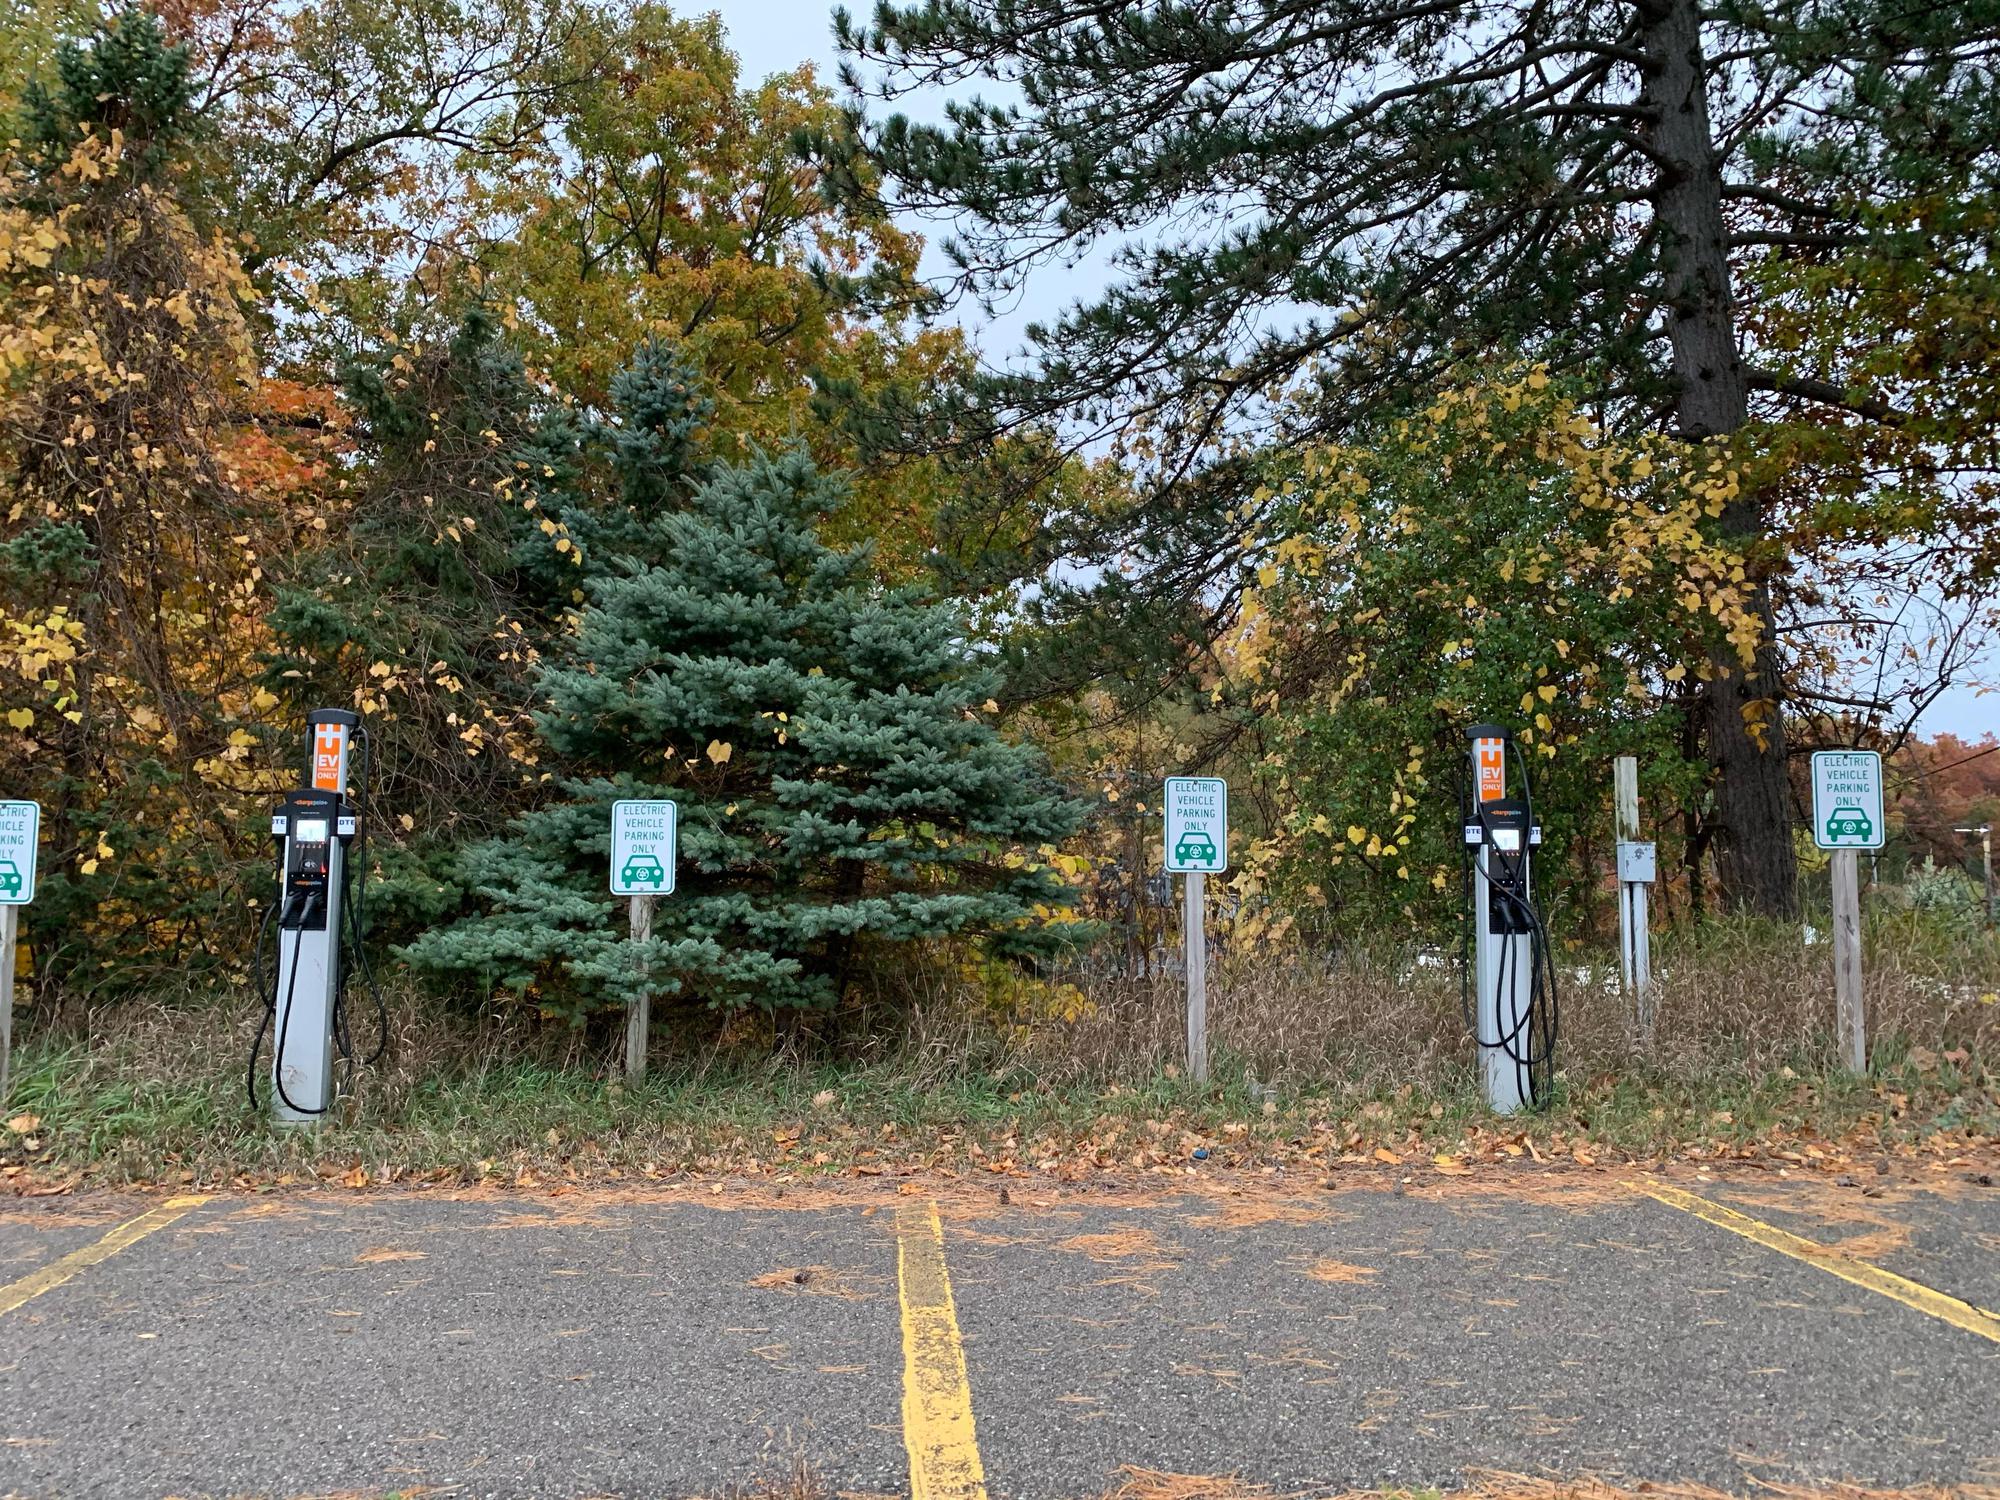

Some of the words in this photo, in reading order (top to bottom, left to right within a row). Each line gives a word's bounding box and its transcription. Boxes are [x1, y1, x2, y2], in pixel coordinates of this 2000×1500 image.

[318, 754, 338, 767] EV
[1823, 756, 1870, 767] ELECTRIC
[317, 772, 337, 780] ONLY
[1482, 767, 1500, 779] EV
[1826, 770, 1868, 780] VEHICLE
[1175, 782, 1217, 793] ELECTRIC
[1826, 783, 1870, 793] PARKING
[1177, 795, 1215, 806] VEHICLE
[1835, 796, 1861, 806] ONLY
[623, 805, 667, 815] ELECTRIC
[1177, 808, 1216, 818] PARKING
[0, 820, 25, 831] ICLE
[625, 818, 664, 828] VEHICLE
[1184, 821, 1207, 831] ONLY
[0, 834, 25, 846] KING
[624, 831, 665, 841] PARKING
[631, 844, 656, 853] ONLY
